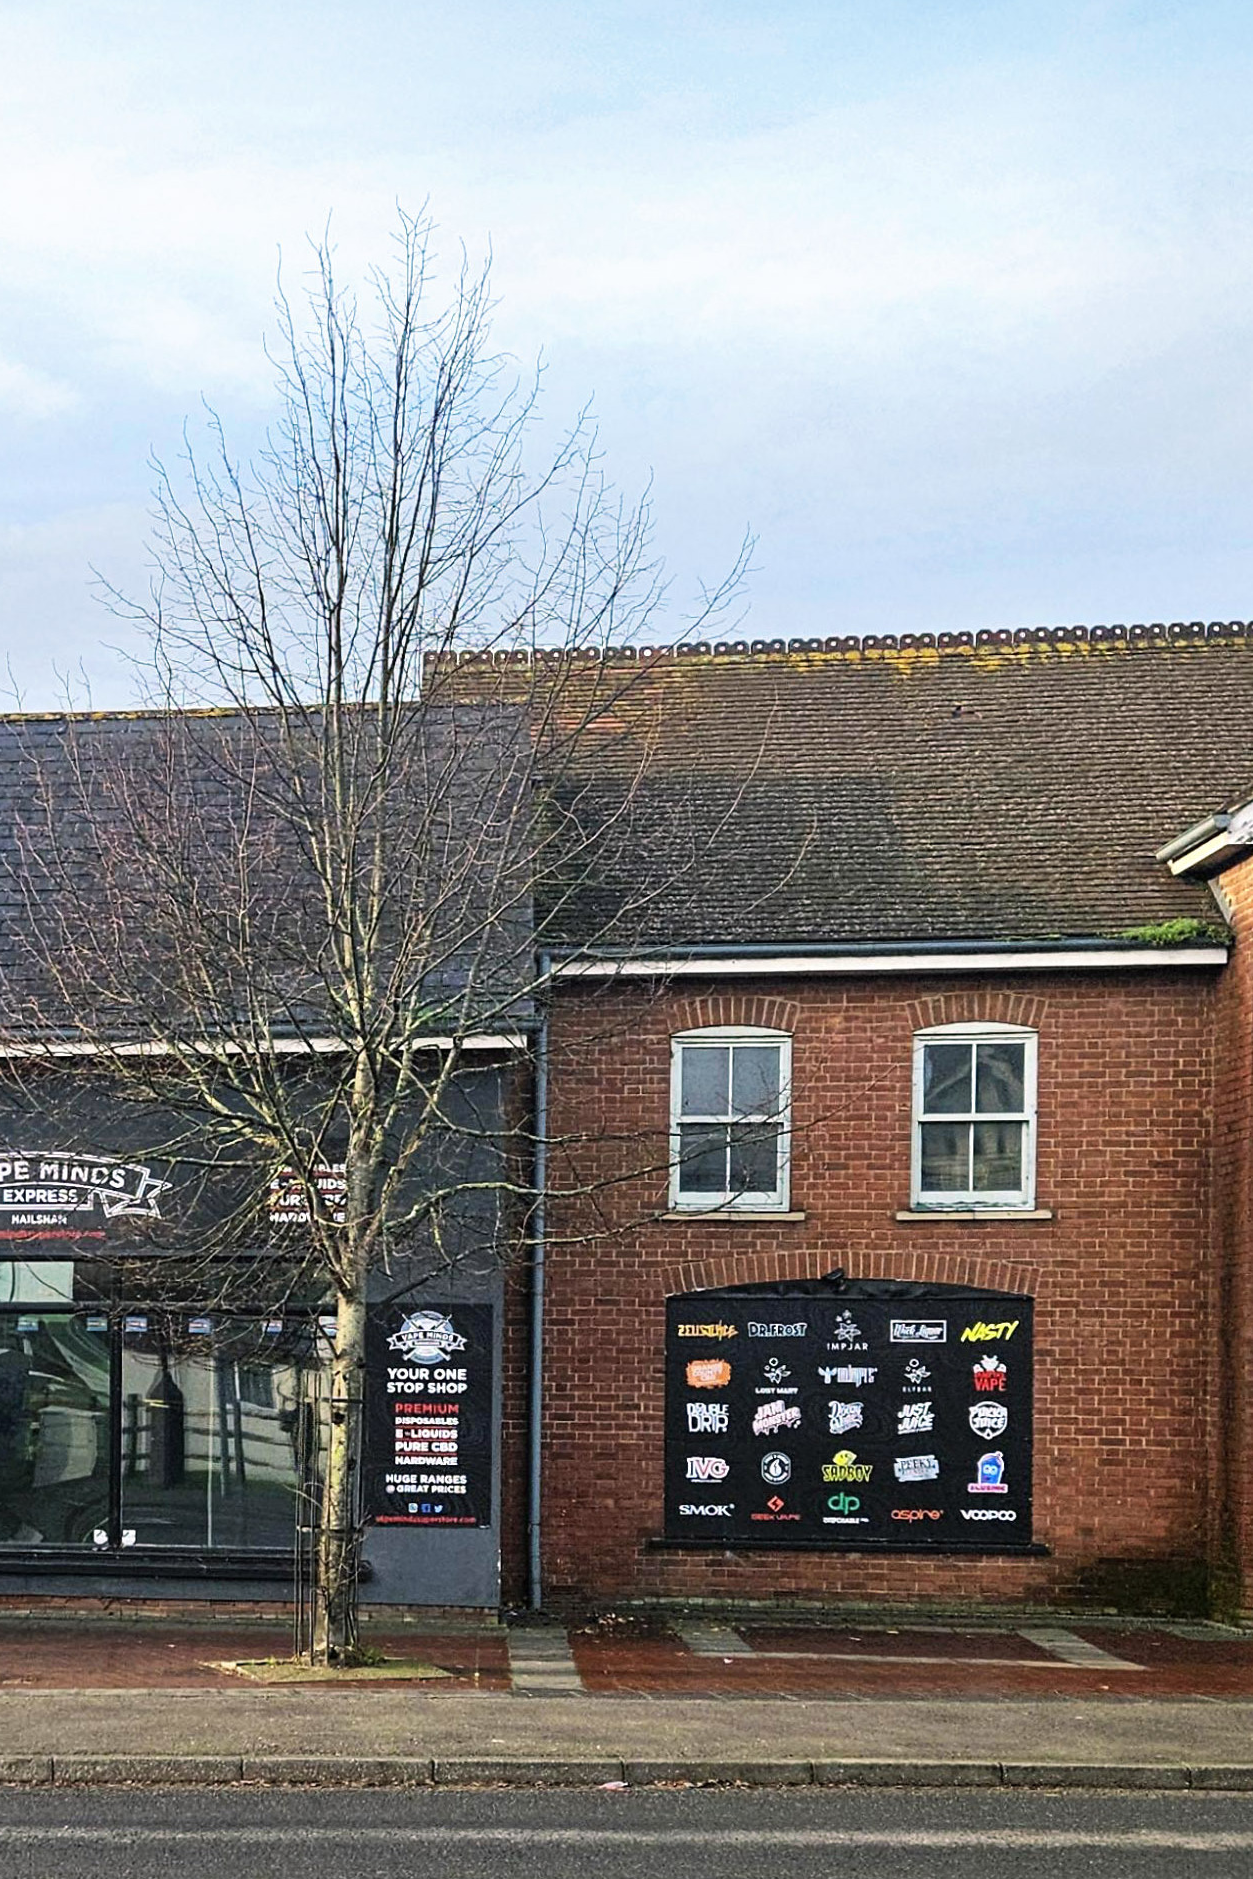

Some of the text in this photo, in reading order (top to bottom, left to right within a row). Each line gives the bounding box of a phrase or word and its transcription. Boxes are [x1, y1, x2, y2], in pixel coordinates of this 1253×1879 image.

[39, 1162, 126, 1189] MINDS
[3, 1188, 78, 1203] EXPRESS
[401, 1332, 454, 1340] VAPE MINDS
[961, 1321, 1019, 1342] NASTY
[387, 1368, 467, 1380] YOUR ONE
[387, 1382, 468, 1394] STOP SHOP
[974, 1378, 1007, 1392] VAPE
[395, 1403, 459, 1414] PREMIUM
[686, 1402, 729, 1416] DOUBLE
[754, 1400, 786, 1420] JAM
[897, 1402, 934, 1418] JUST
[395, 1417, 459, 1425] DISPOSABLES
[752, 1407, 800, 1433] MONSTER
[897, 1416, 934, 1431] JUICE
[973, 1417, 1005, 1429] JUICE
[395, 1442, 458, 1452] PURE CBD
[395, 1456, 458, 1465] HARDWARE
[686, 1457, 730, 1479] IVG
[821, 1464, 873, 1482] SADBOY
[385, 1474, 467, 1484] HUGE RANGES
[396, 1485, 428, 1493] GREAT
[431, 1485, 467, 1494] PRICES
[679, 1505, 732, 1516] SMOK
[891, 1509, 941, 1523] aspire
[960, 1509, 1017, 1521] VOOPOO
